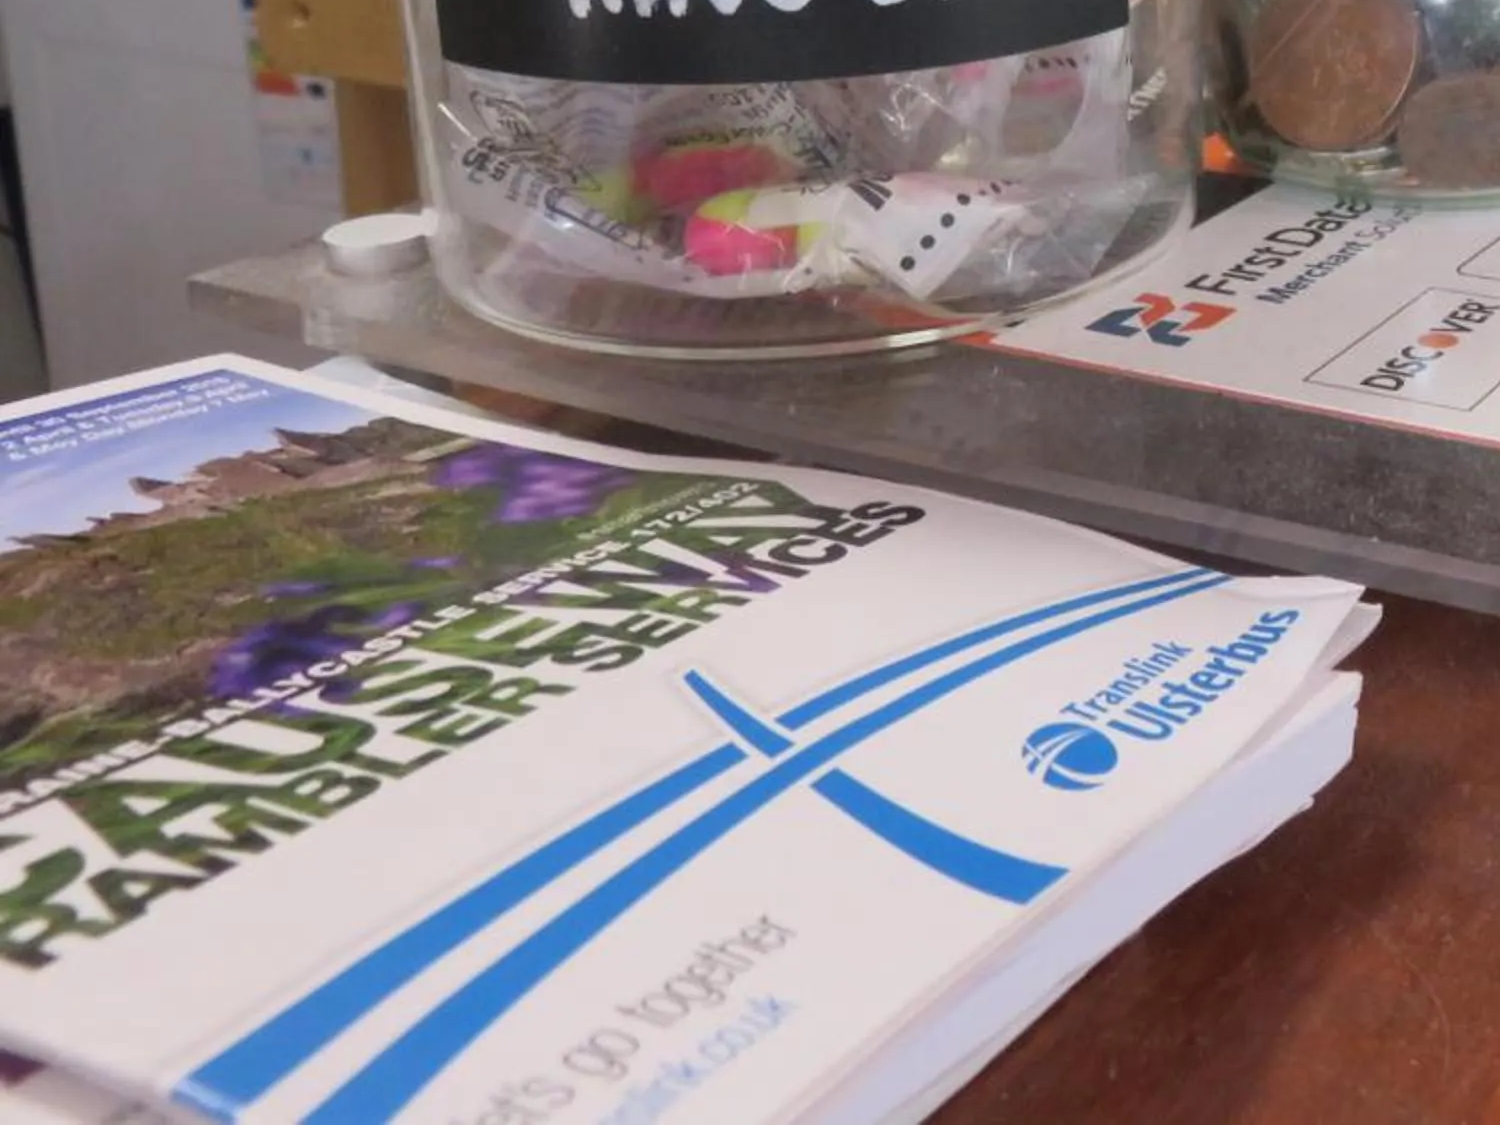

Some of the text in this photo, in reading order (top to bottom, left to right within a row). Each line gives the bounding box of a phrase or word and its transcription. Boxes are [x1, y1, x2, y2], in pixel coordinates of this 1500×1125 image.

[1256, 240, 1373, 305] Merchant
[473, 539, 630, 606] SERVICE
[550, 500, 926, 673] SERVICES
[1059, 640, 1195, 723] Translink
[1105, 607, 1300, 742] Ulsterbus
[562, 1027, 640, 1081] go
[614, 913, 799, 1027] together
